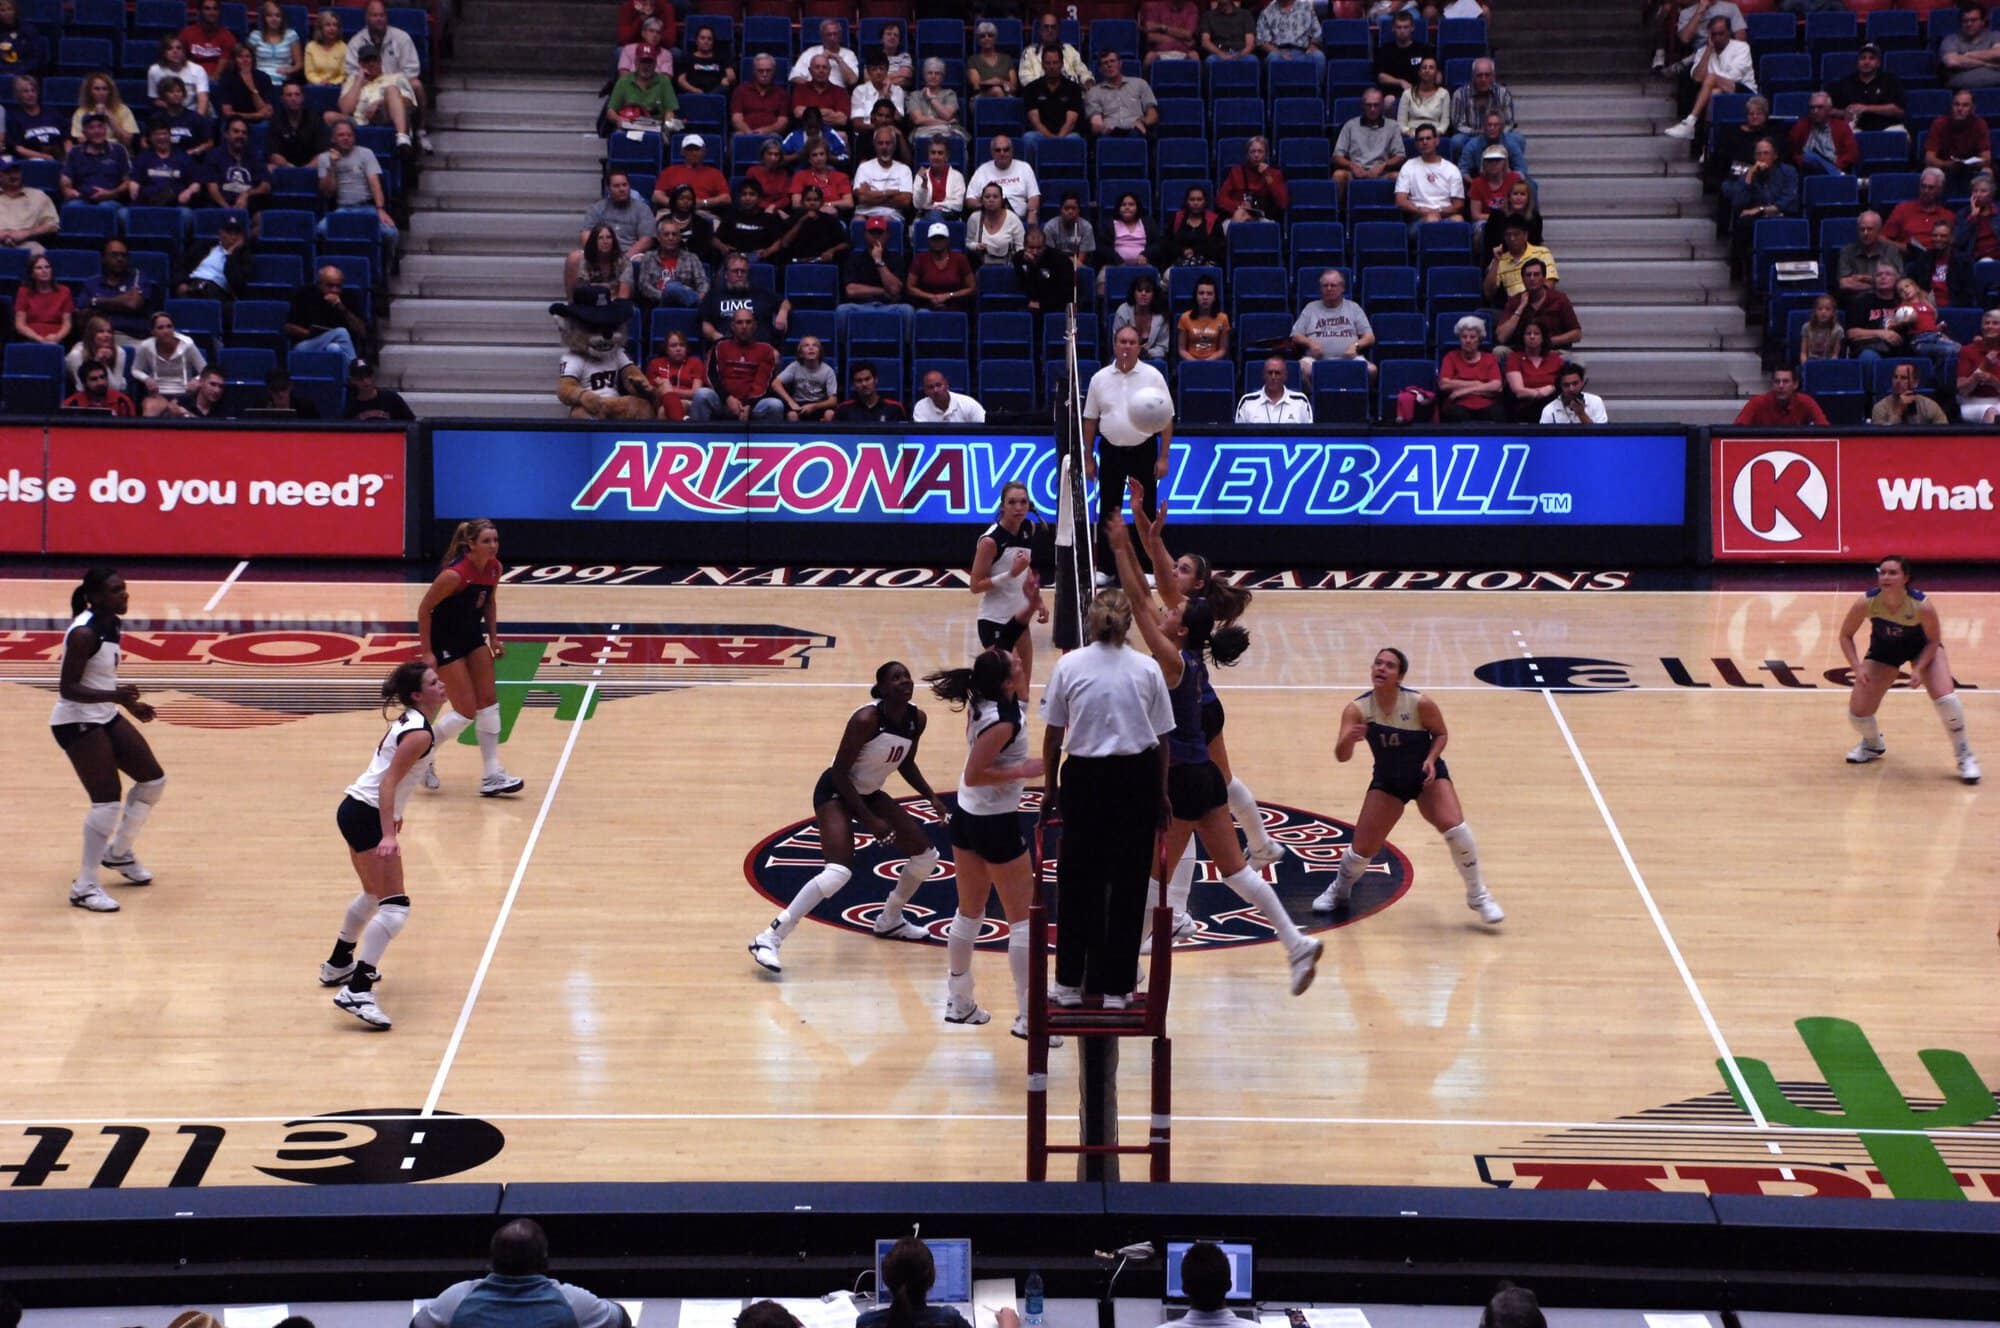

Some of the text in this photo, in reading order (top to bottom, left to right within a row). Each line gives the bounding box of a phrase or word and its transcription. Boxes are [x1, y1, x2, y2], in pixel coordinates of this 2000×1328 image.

[720, 299, 753, 312] UMC
[1315, 315, 1352, 329] ARIZONA
[571, 441, 969, 514] ARIZONA
[89, 469, 147, 504] do
[157, 478, 237, 512] you
[249, 473, 384, 507] need?
[1877, 477, 1994, 511] What
[499, 564, 663, 584] 1997
[1380, 732, 1402, 748] 14
[885, 745, 905, 763] 10
